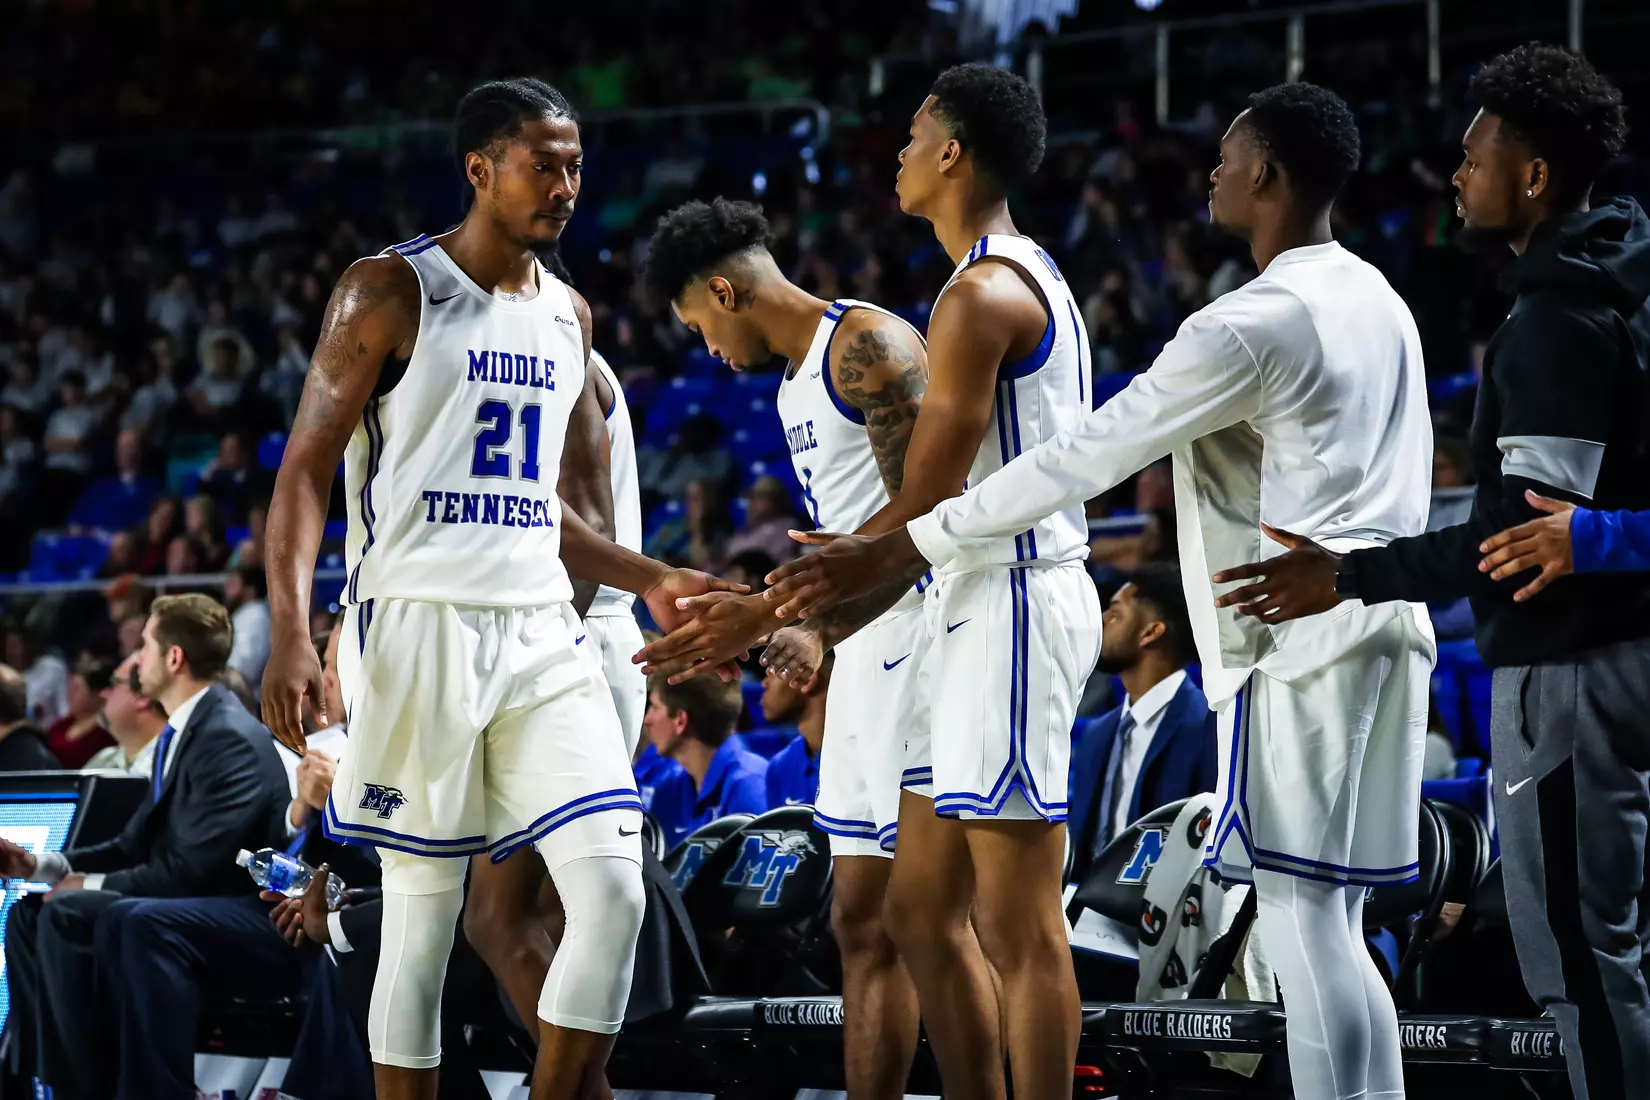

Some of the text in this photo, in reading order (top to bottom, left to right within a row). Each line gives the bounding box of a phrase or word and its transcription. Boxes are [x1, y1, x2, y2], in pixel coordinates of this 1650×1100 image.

[467, 349, 555, 391] MIDDLE
[469, 398, 542, 484] 21
[359, 784, 404, 819] MT
[723, 834, 801, 907] MT
[764, 1004, 796, 1024] BLUE
[1124, 1012, 1232, 1038] BLUE RAIDERS
[1399, 1025, 1447, 1048] IDERS
[1511, 1031, 1554, 1056] BLUE
